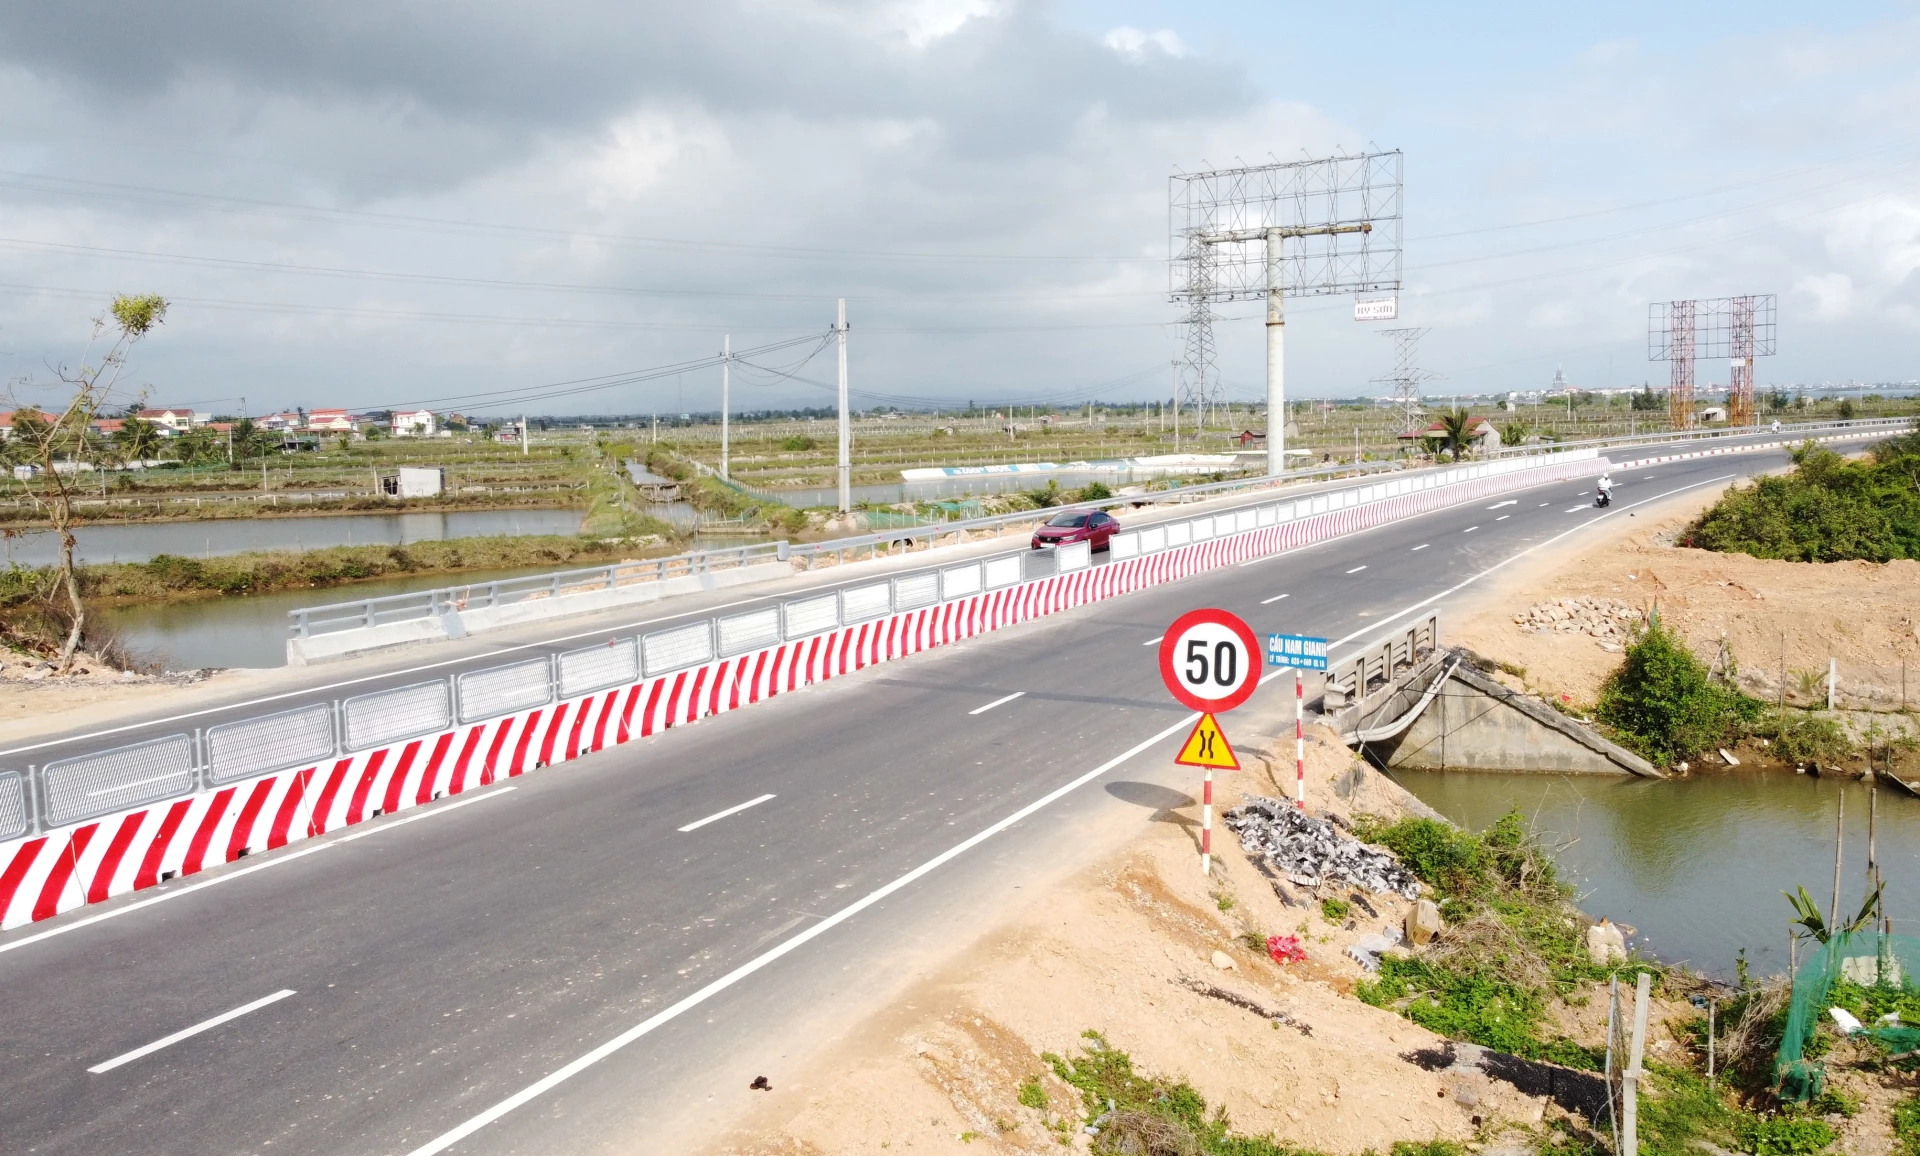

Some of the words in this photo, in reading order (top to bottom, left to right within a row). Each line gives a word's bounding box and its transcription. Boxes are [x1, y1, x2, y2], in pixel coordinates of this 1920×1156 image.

[1186, 639, 1237, 687] 50
[1285, 639, 1302, 655] NAM
[1303, 641, 1327, 657] GIANH
